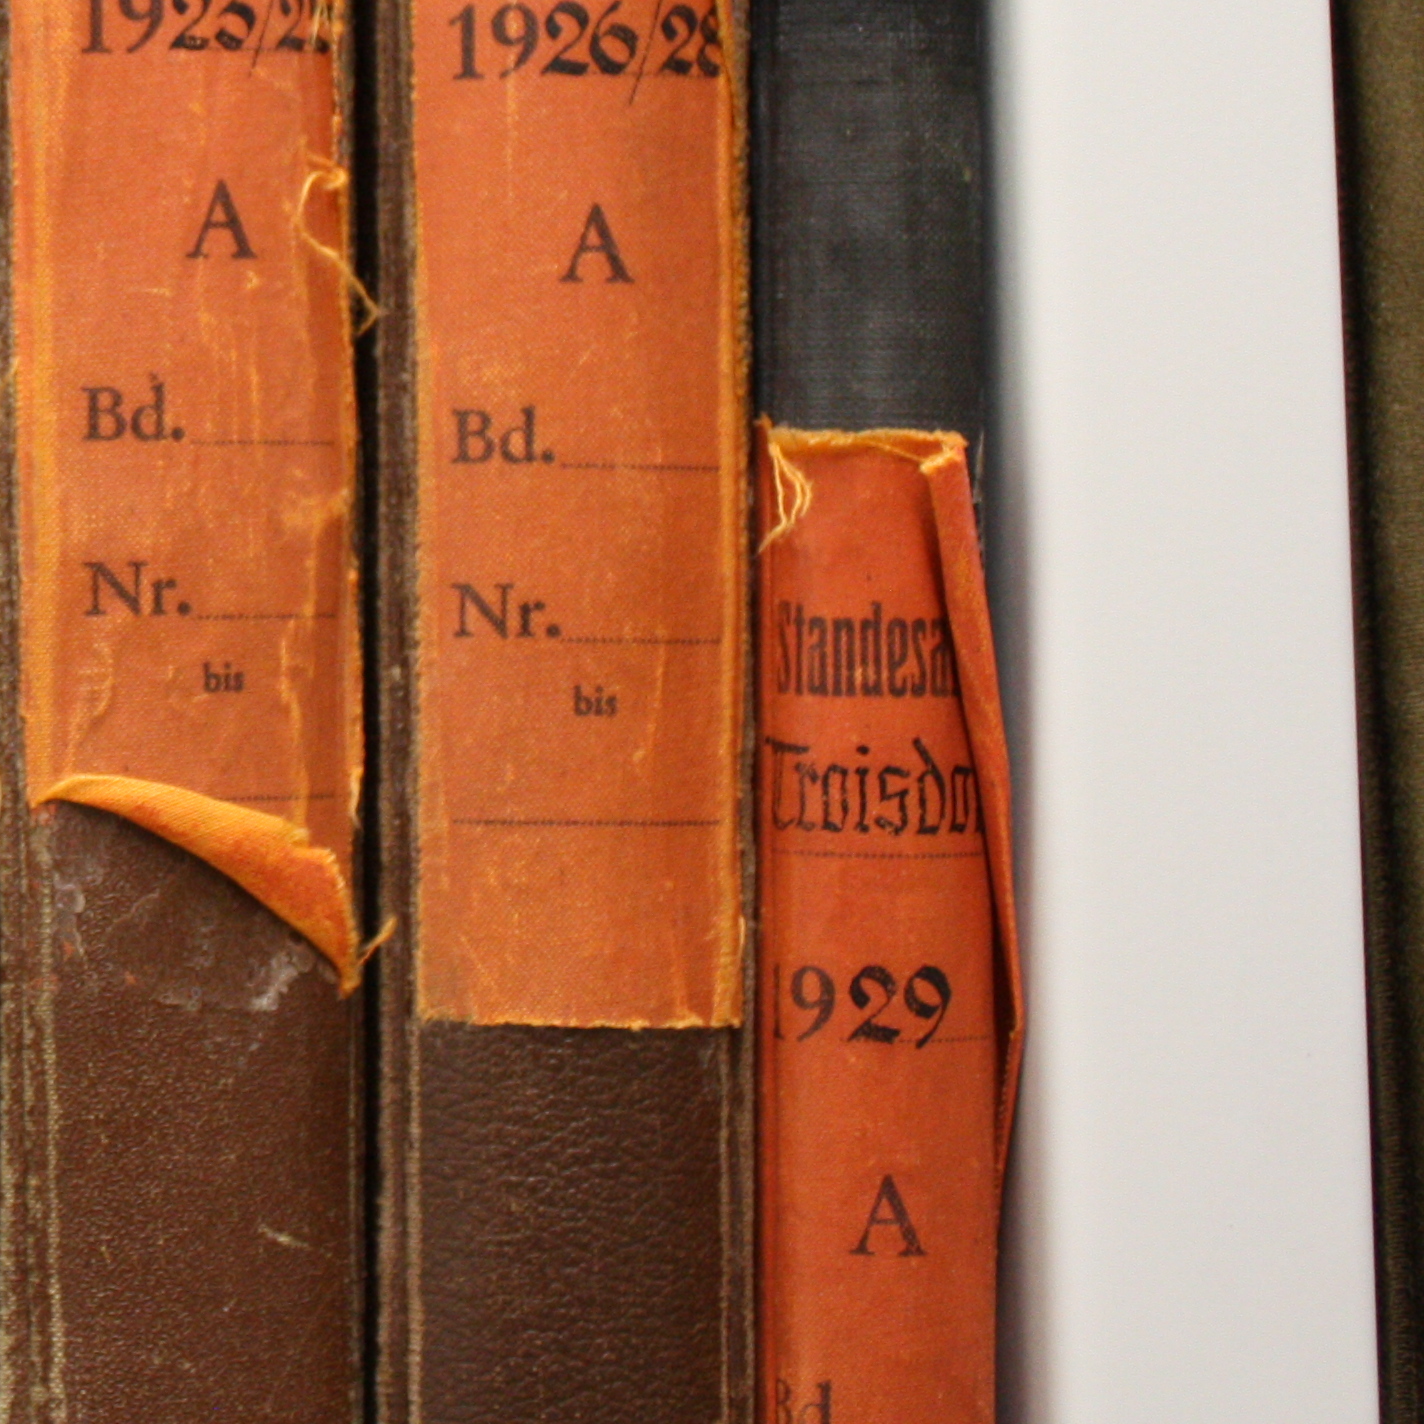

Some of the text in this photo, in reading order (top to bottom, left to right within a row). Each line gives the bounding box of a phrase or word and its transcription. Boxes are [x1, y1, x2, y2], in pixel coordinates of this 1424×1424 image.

[185, 179, 257, 259] A
[559, 202, 635, 283] A
[81, 375, 186, 444] Bd.
[452, 405, 556, 464] Bd.
[83, 561, 191, 618] Nr.
[452, 582, 562, 639] Nr.
[203, 662, 245, 694] bis
[777, 600, 961, 700] Standesa
[573, 684, 618, 717] bis
[850, 1174, 927, 1258] A
